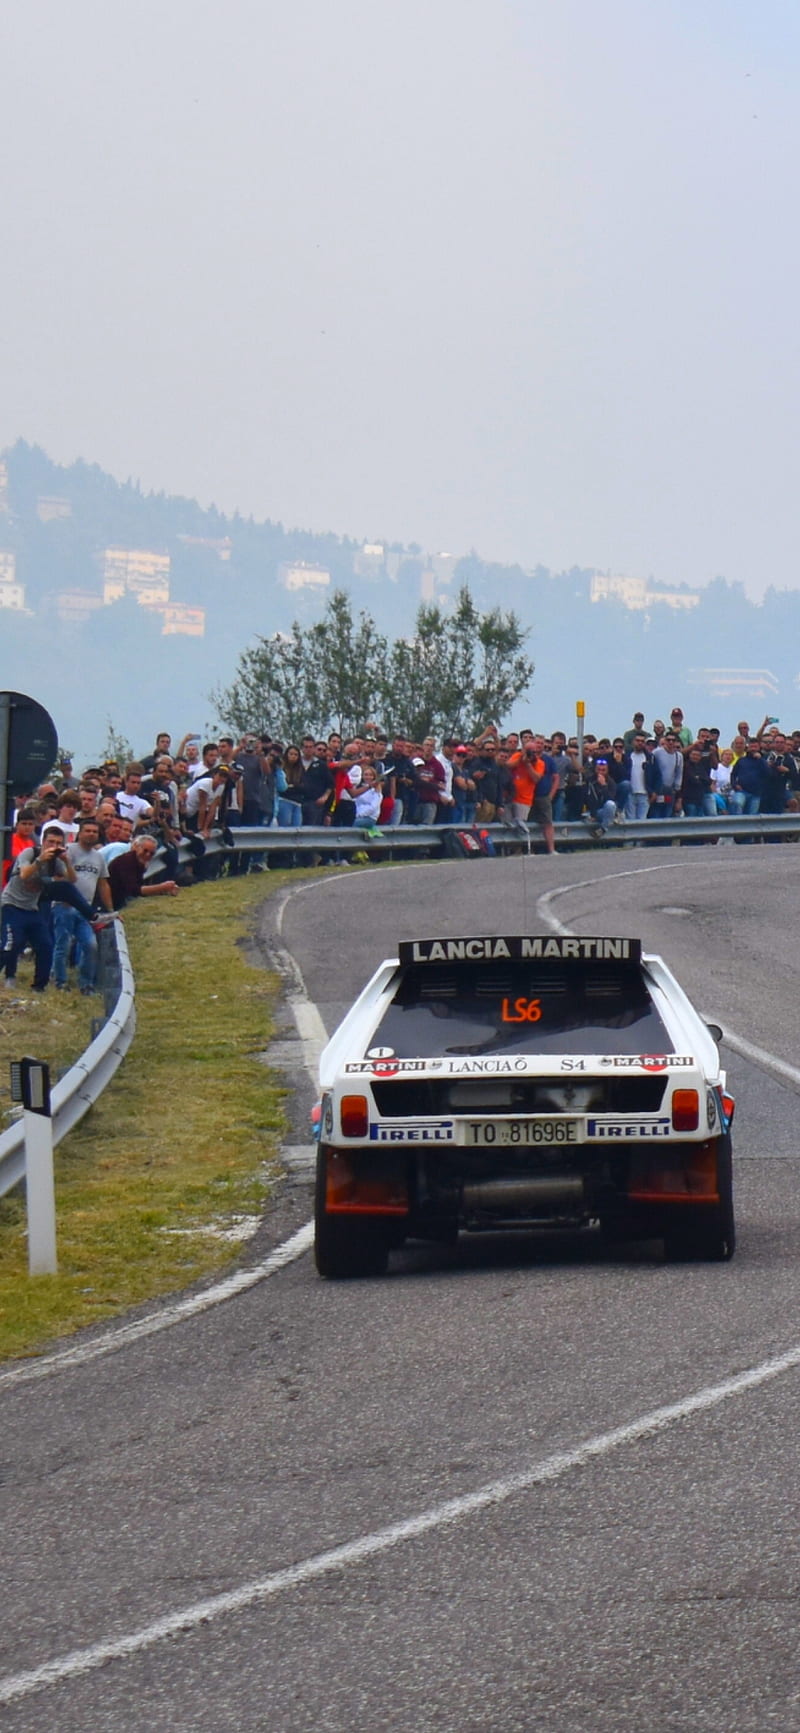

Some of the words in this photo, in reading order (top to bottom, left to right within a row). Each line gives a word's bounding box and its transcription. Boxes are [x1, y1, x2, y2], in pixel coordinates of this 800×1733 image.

[74, 864, 99, 874] adida
[412, 938, 511, 962] LANCIA
[521, 938, 630, 959] MARTINI
[501, 997, 542, 1022] LS6
[347, 1061, 424, 1073] MARTINI
[560, 1058, 587, 1071] S4
[616, 1056, 691, 1067] MARTINI
[369, 1121, 453, 1141] PIRELLI
[510, 1121, 577, 1143] 81696E
[587, 1117, 671, 1137] PIRELLI
